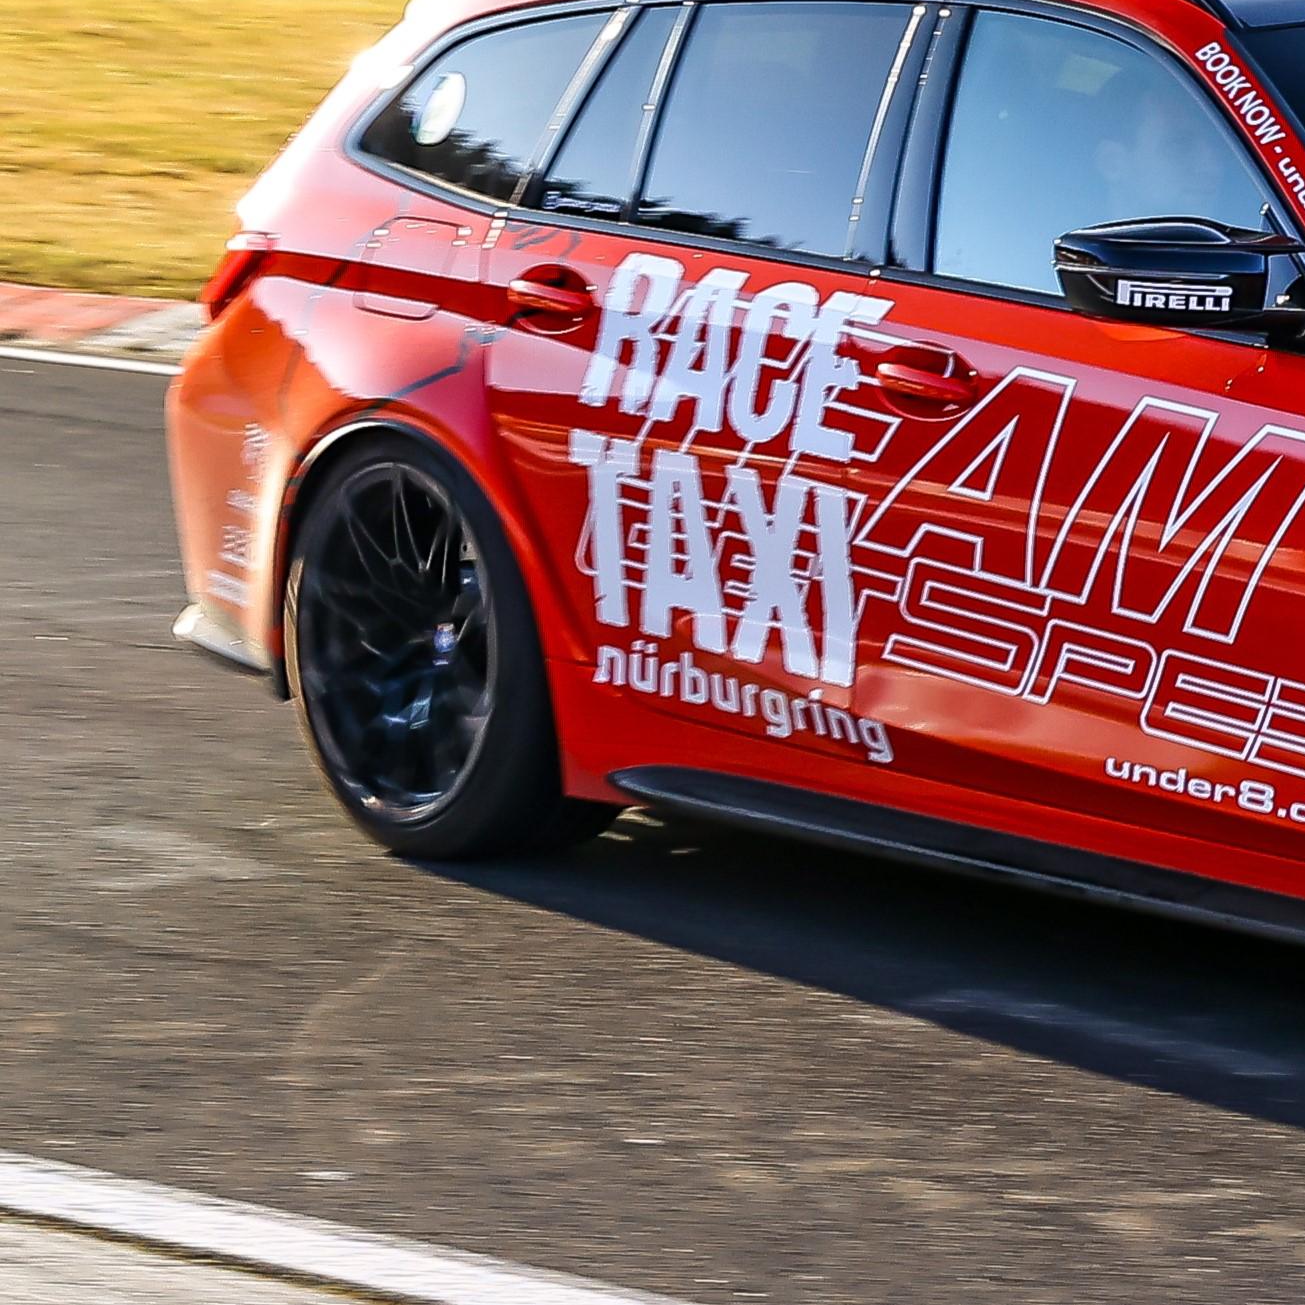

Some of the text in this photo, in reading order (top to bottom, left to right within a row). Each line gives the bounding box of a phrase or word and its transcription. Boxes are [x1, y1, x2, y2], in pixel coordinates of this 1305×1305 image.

[1195, 42, 1252, 100] BOOK
[1234, 90, 1287, 145] NOW
[1116, 279, 1233, 312] PIRELLI
[578, 253, 896, 463] RACE
[568, 428, 856, 688] TAXI
[592, 639, 894, 763] nürburgring
